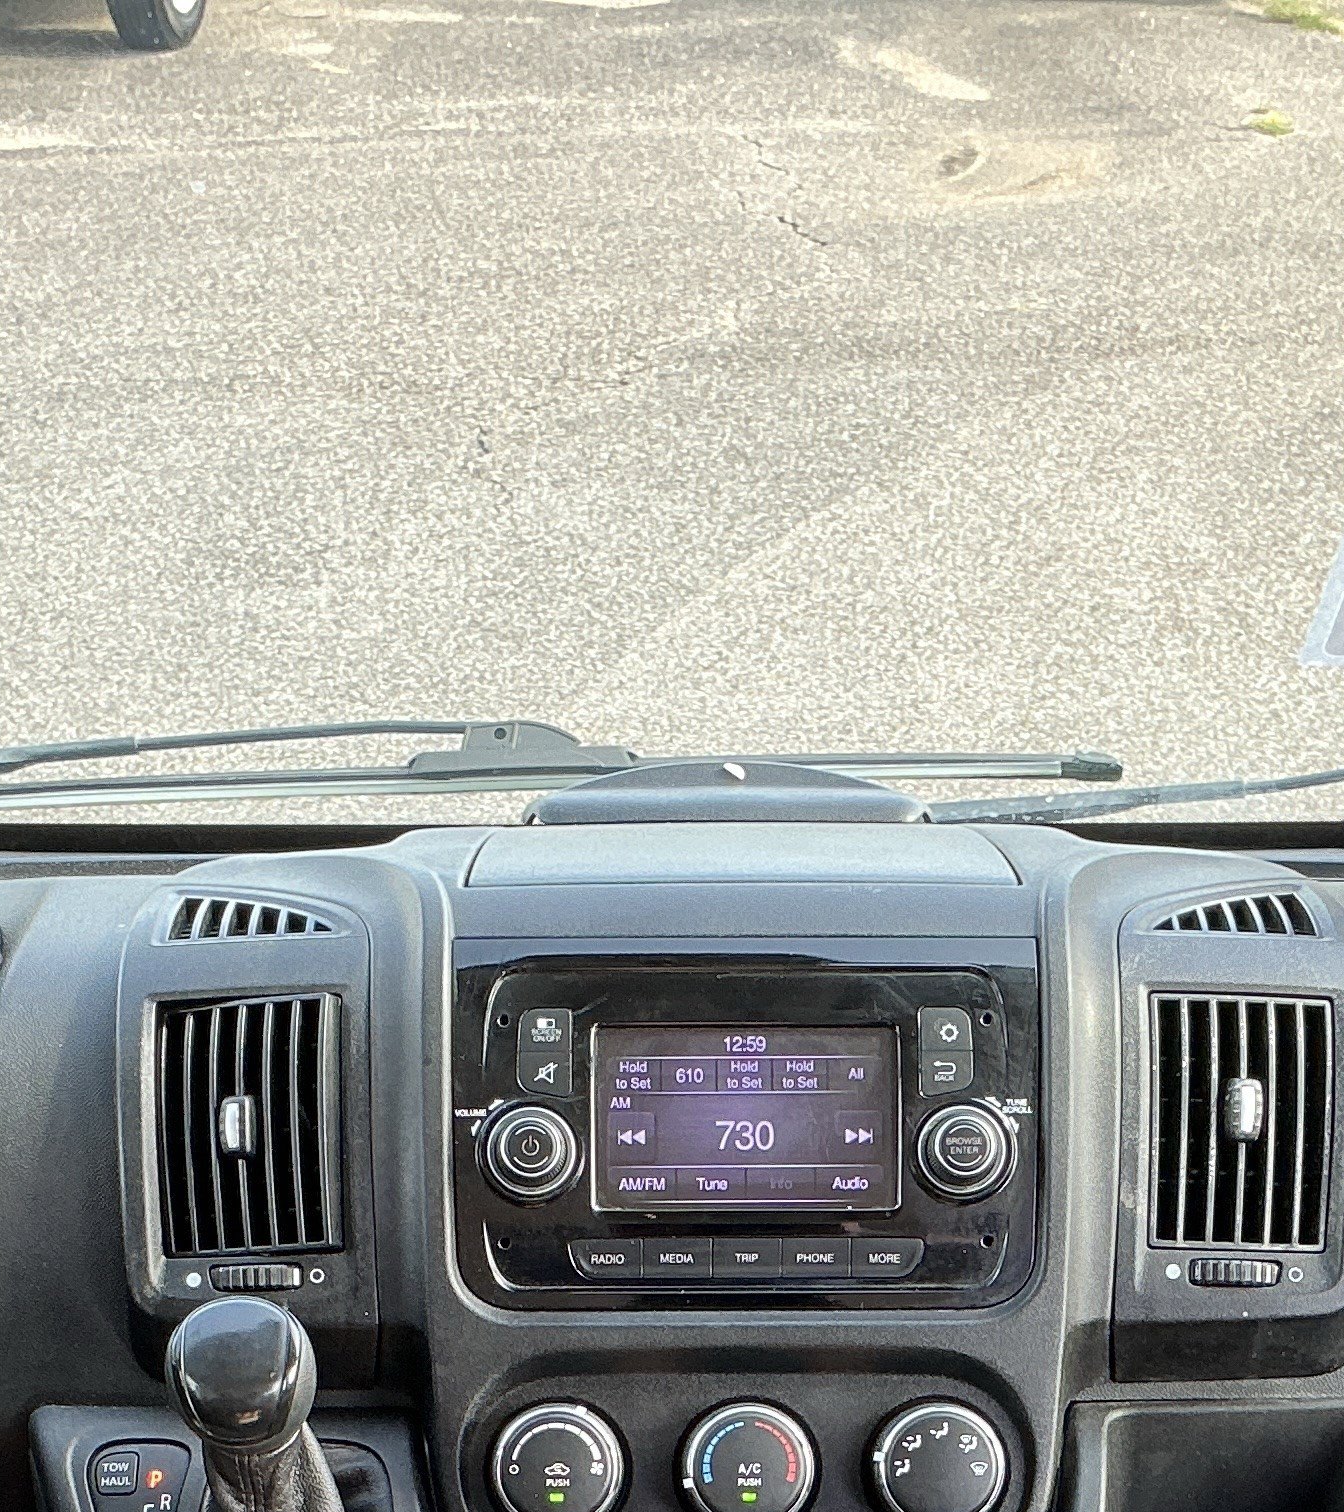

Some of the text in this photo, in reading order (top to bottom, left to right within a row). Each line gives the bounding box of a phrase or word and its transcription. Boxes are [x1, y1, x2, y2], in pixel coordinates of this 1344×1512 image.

[722, 1035, 767, 1053] 12:59
[619, 1060, 648, 1074] Hold
[730, 1060, 759, 1073] Hold
[785, 1059, 814, 1073] Hold
[675, 1068, 704, 1084] 610
[848, 1067, 865, 1080] All
[615, 1078, 652, 1090] to Set
[726, 1078, 763, 1090] to Set
[781, 1077, 818, 1089] to Set
[610, 1096, 632, 1110] AM
[1001, 1105, 1033, 1114] SCROLL
[454, 1108, 488, 1118] VOLUME
[715, 1120, 776, 1152] 730
[945, 1136, 983, 1146] BROWSE
[950, 1146, 979, 1155] ENTER
[618, 1177, 667, 1192] AM/FM
[695, 1177, 728, 1191] Tune
[831, 1176, 870, 1191] Audio
[591, 1252, 626, 1265] RADIO
[659, 1252, 694, 1265] MEDIA
[735, 1252, 759, 1265] TRIP
[796, 1252, 835, 1265] PHONE
[868, 1252, 902, 1265] MORE
[101, 1462, 130, 1473] TOW
[737, 1462, 762, 1475] A/C
[100, 1475, 132, 1487] HAUL
[149, 1470, 164, 1488] P
[546, 1478, 571, 1487] PUSH
[737, 1477, 763, 1488] PUSH
[159, 1493, 173, 1511] R
